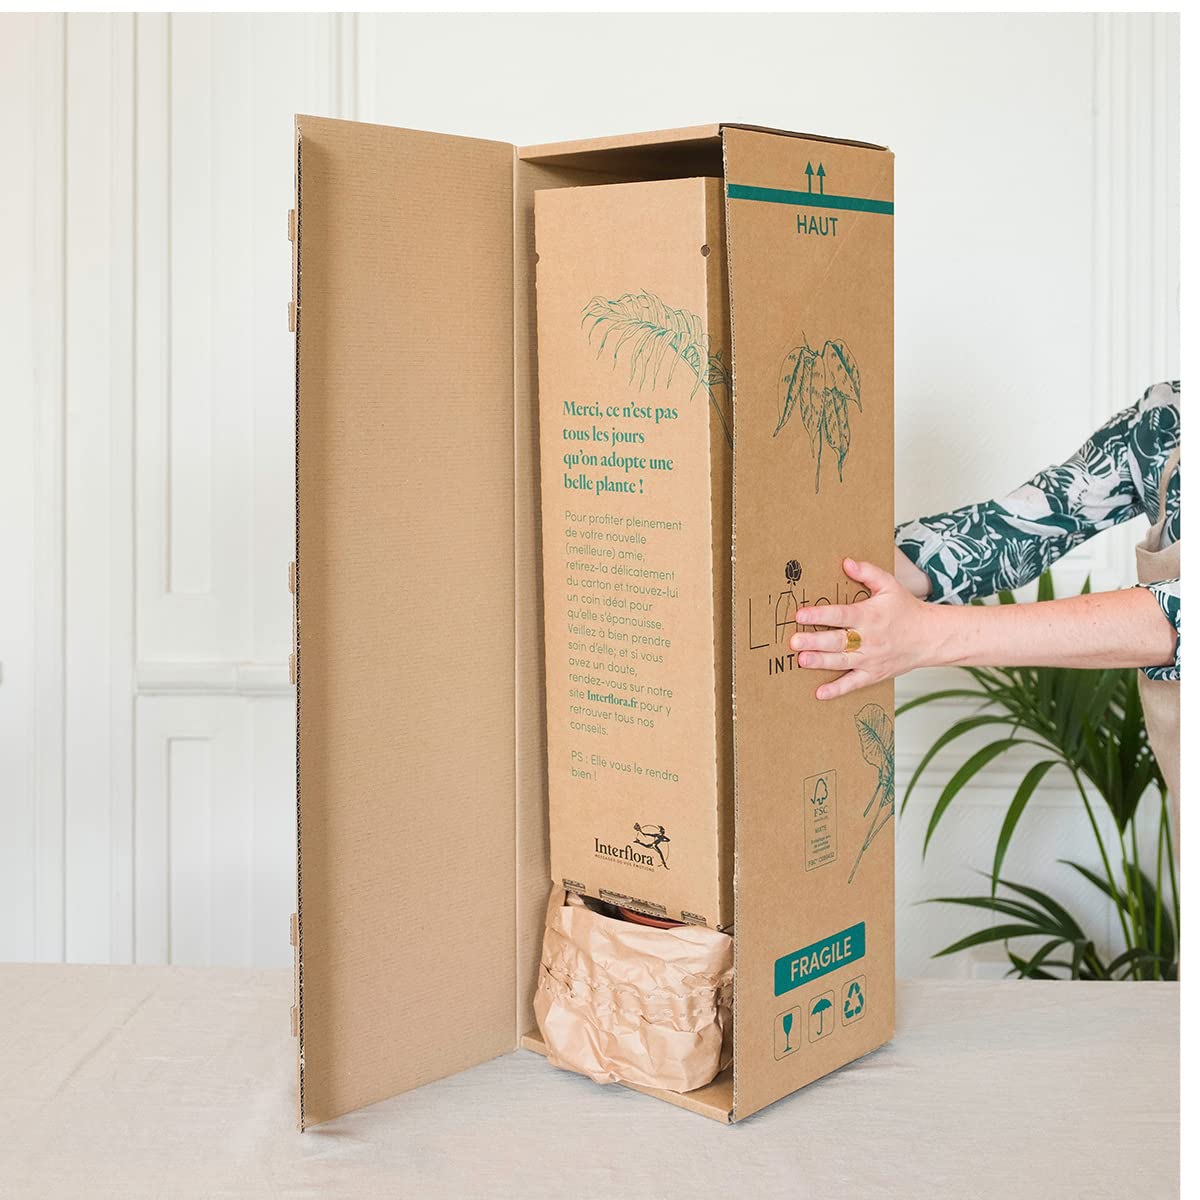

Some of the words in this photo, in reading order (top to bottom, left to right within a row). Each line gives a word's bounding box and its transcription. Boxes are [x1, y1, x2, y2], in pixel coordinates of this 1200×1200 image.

[796, 214, 839, 237] HAUT
[563, 401, 603, 418] Merci,
[606, 406, 620, 417] ce
[655, 407, 678, 424] pas
[563, 428, 590, 441] tous
[592, 426, 609, 442] les
[611, 427, 645, 447] jours
[600, 451, 646, 473] adopte
[650, 458, 674, 471] une
[564, 473, 593, 490] belle
[596, 476, 636, 495] plante
[565, 510, 586, 522] Pour
[588, 513, 624, 526] profiter
[626, 516, 682, 531] pleinement
[565, 527, 578, 538] de
[580, 530, 603, 541] votre
[606, 532, 646, 544] nouvelle
[565, 542, 616, 559] (meilleure)
[618, 550, 645, 562] amie,
[566, 560, 608, 574] retirez-la
[611, 564, 675, 581] délicatement
[566, 576, 578, 586] du
[581, 578, 612, 590] carton
[614, 582, 624, 592] et
[626, 582, 679, 599] trouvez-lui
[567, 594, 578, 602] un
[581, 595, 601, 605] coin
[602, 596, 627, 609] idéal
[630, 600, 653, 612] pour
[568, 623, 596, 637] Veillez
[598, 628, 605, 638] à
[608, 629, 629, 641] bien
[632, 633, 671, 648] prendre
[568, 640, 587, 652] soin
[619, 648, 628, 658] et
[631, 648, 638, 659] si
[640, 652, 664, 664] vous
[568, 657, 590, 668] avez
[593, 662, 605, 671] un
[608, 662, 638, 678] doute,
[568, 672, 628, 691] rendez-vous
[630, 684, 645, 693] sur
[647, 686, 673, 698] notre
[569, 688, 585, 699] site
[587, 690, 638, 708] Interflora.fr
[640, 701, 664, 713] pour
[666, 706, 672, 717] y
[570, 705, 612, 720] retrouver
[614, 712, 635, 724] tous
[638, 717, 655, 728] nos
[570, 720, 609, 736] conseils.
[571, 750, 583, 762] PS
[591, 754, 607, 768] Elle
[609, 761, 632, 773] vous
[634, 763, 643, 775] le
[646, 768, 679, 782] rendra
[571, 768, 592, 780] bien
[594, 837, 654, 866] Interflora
[791, 936, 852, 982] FRAGILE
